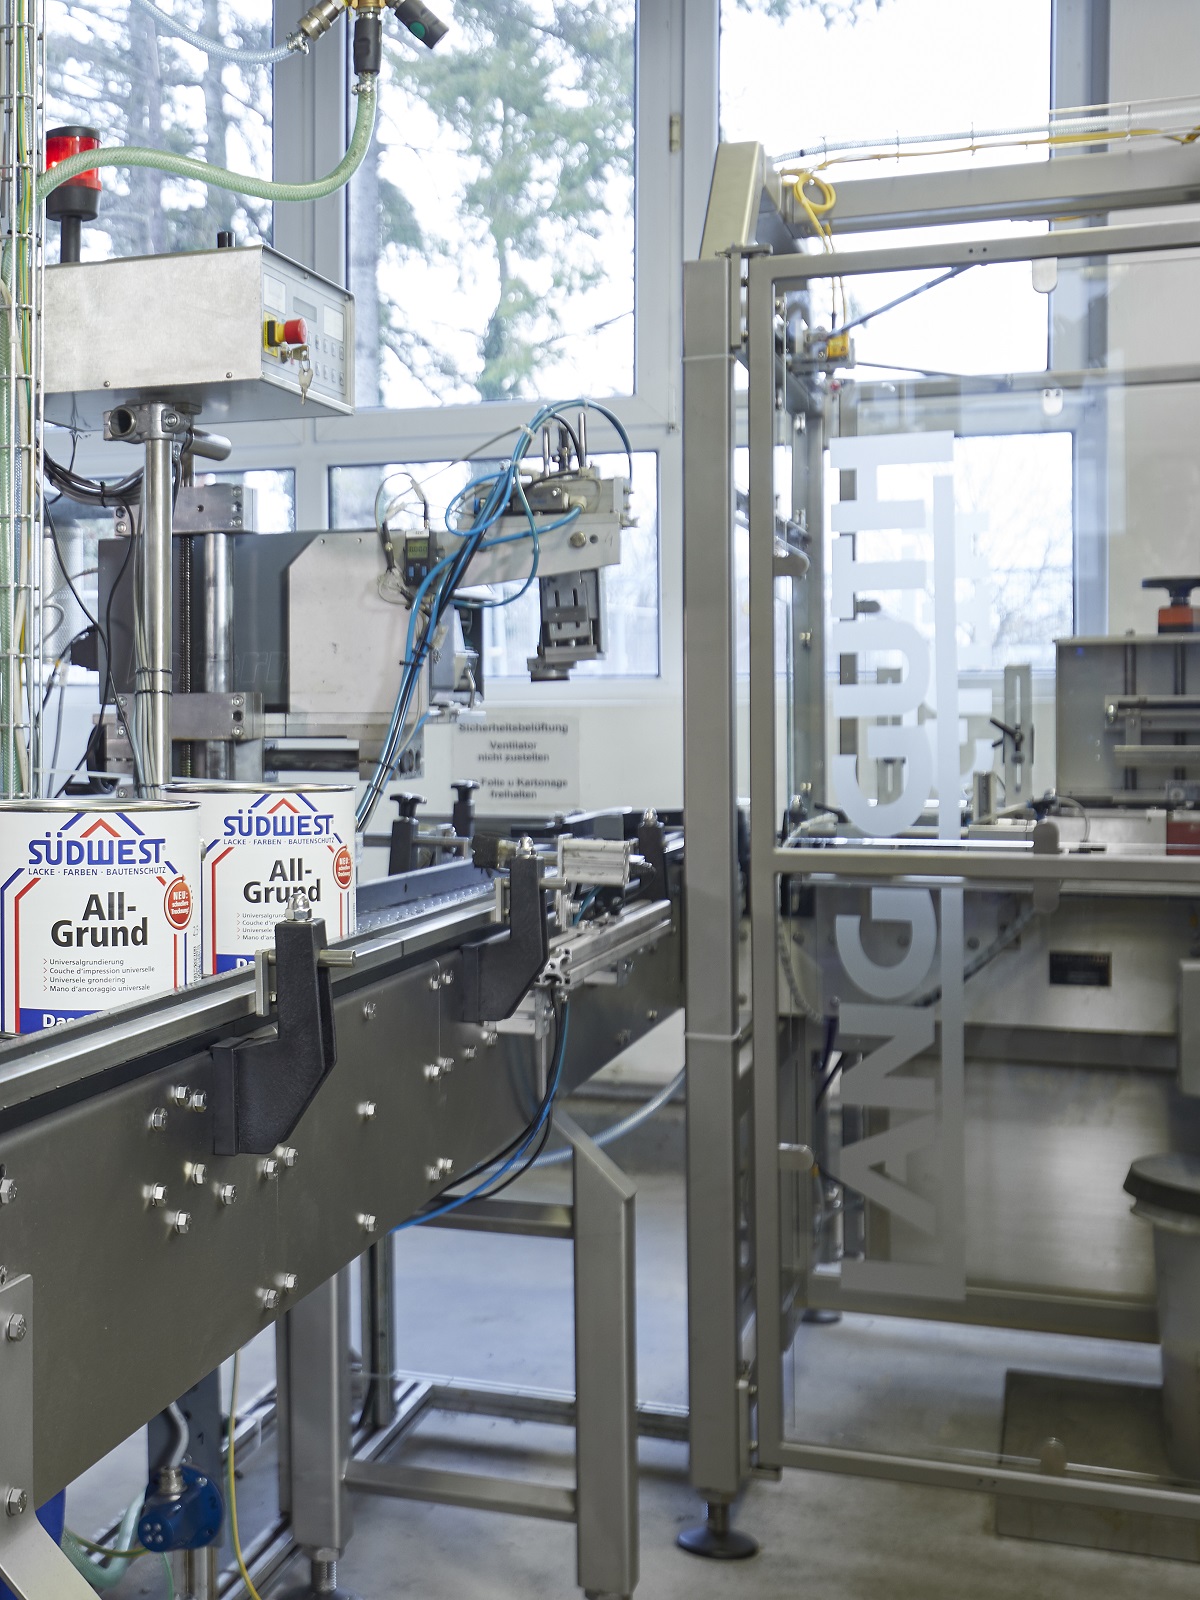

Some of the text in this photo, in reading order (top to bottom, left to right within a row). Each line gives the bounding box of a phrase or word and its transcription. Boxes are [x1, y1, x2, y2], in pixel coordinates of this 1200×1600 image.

[458, 722, 569, 735] Sicherheitsbelüftung
[489, 740, 537, 750] Ventilator
[478, 753, 549, 763] nicht zustellen
[481, 777, 505, 787] Folie
[516, 777, 568, 789] Kartonage
[490, 789, 537, 799] freihalten
[223, 808, 334, 836] SÜDWEST
[288, 836, 335, 845] BAUTENSCHUTZ
[28, 831, 166, 865] SÜDWEST
[268, 857, 313, 882] All-
[829, 429, 966, 1301] LANGGUTH
[28, 866, 167, 876] LACKE FARBEN BAUTENSCHUTZ
[172, 890, 189, 901] NEU:
[81, 891, 137, 921] All-
[51, 916, 148, 948] Grund
[49, 958, 124, 967] Universalgrundierung
[49, 965, 155, 976] Couche d'impression universelle
[49, 976, 126, 985] Universele grondering
[71, 985, 117, 994] d'ancoraggio
[118, 984, 151, 992] universale
